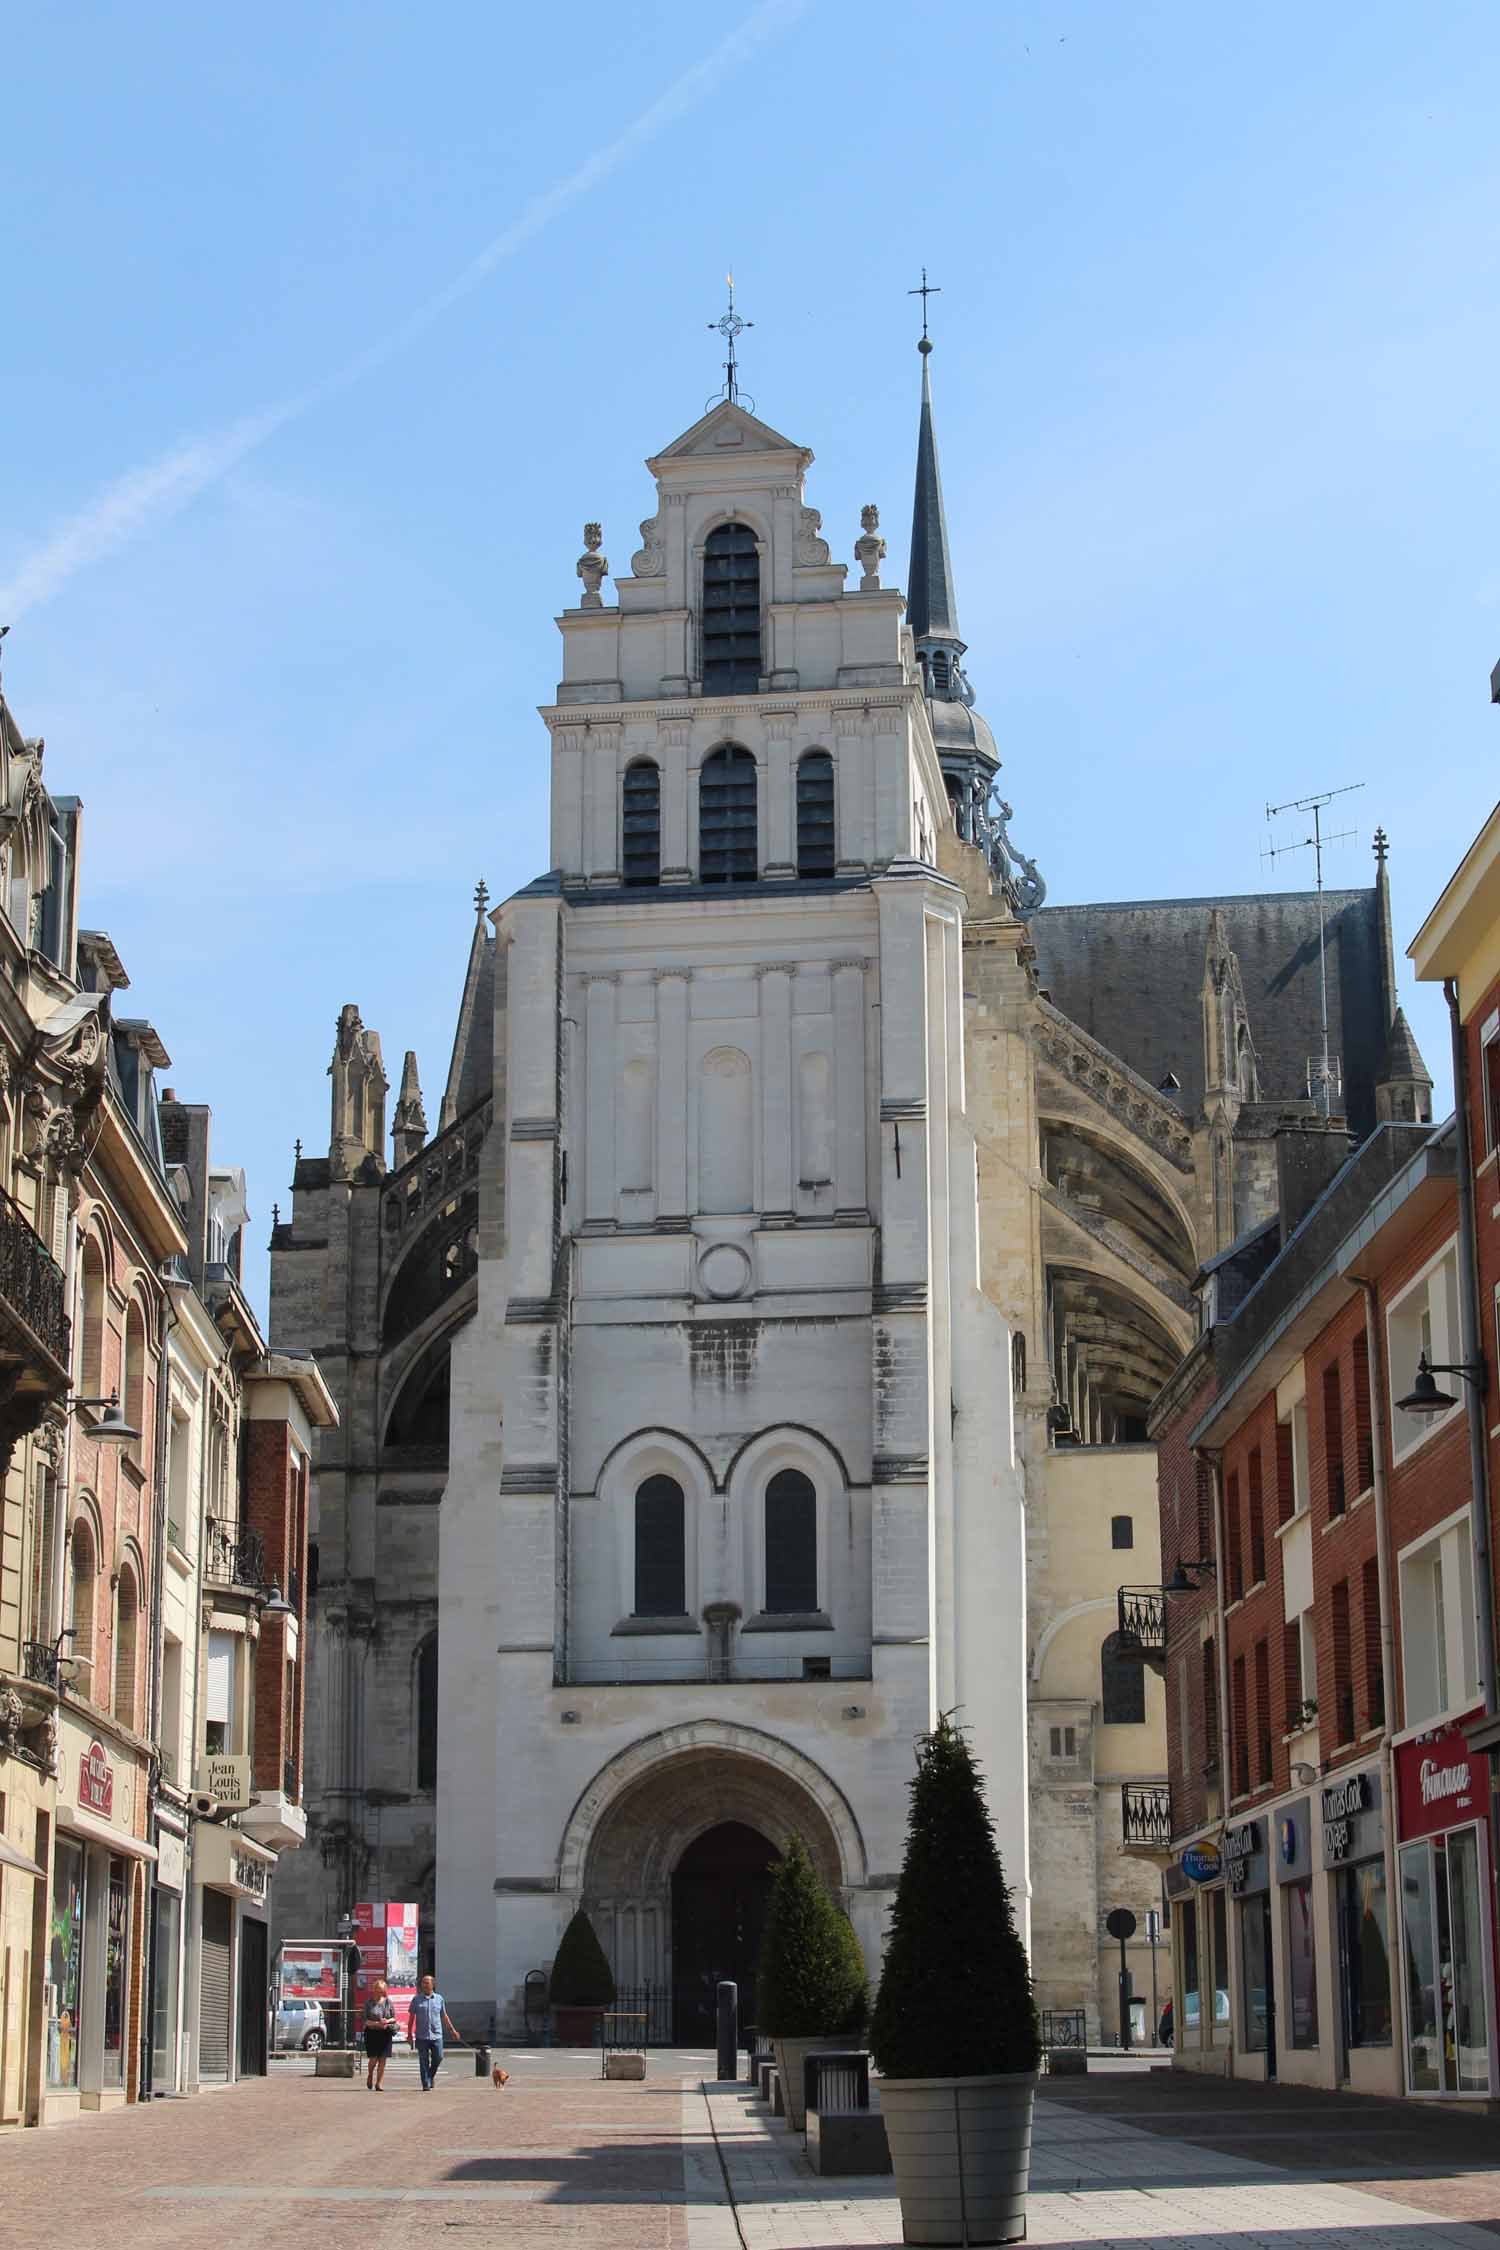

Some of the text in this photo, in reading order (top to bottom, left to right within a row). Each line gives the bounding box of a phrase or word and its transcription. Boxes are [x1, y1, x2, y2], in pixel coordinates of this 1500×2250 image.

[208, 1761, 235, 1775] Jean
[210, 1774, 240, 1788] Louis
[1344, 1774, 1362, 1814] Cook
[1183, 1853, 1220, 1865] Thomas
[1197, 1863, 1219, 1872] Cook
